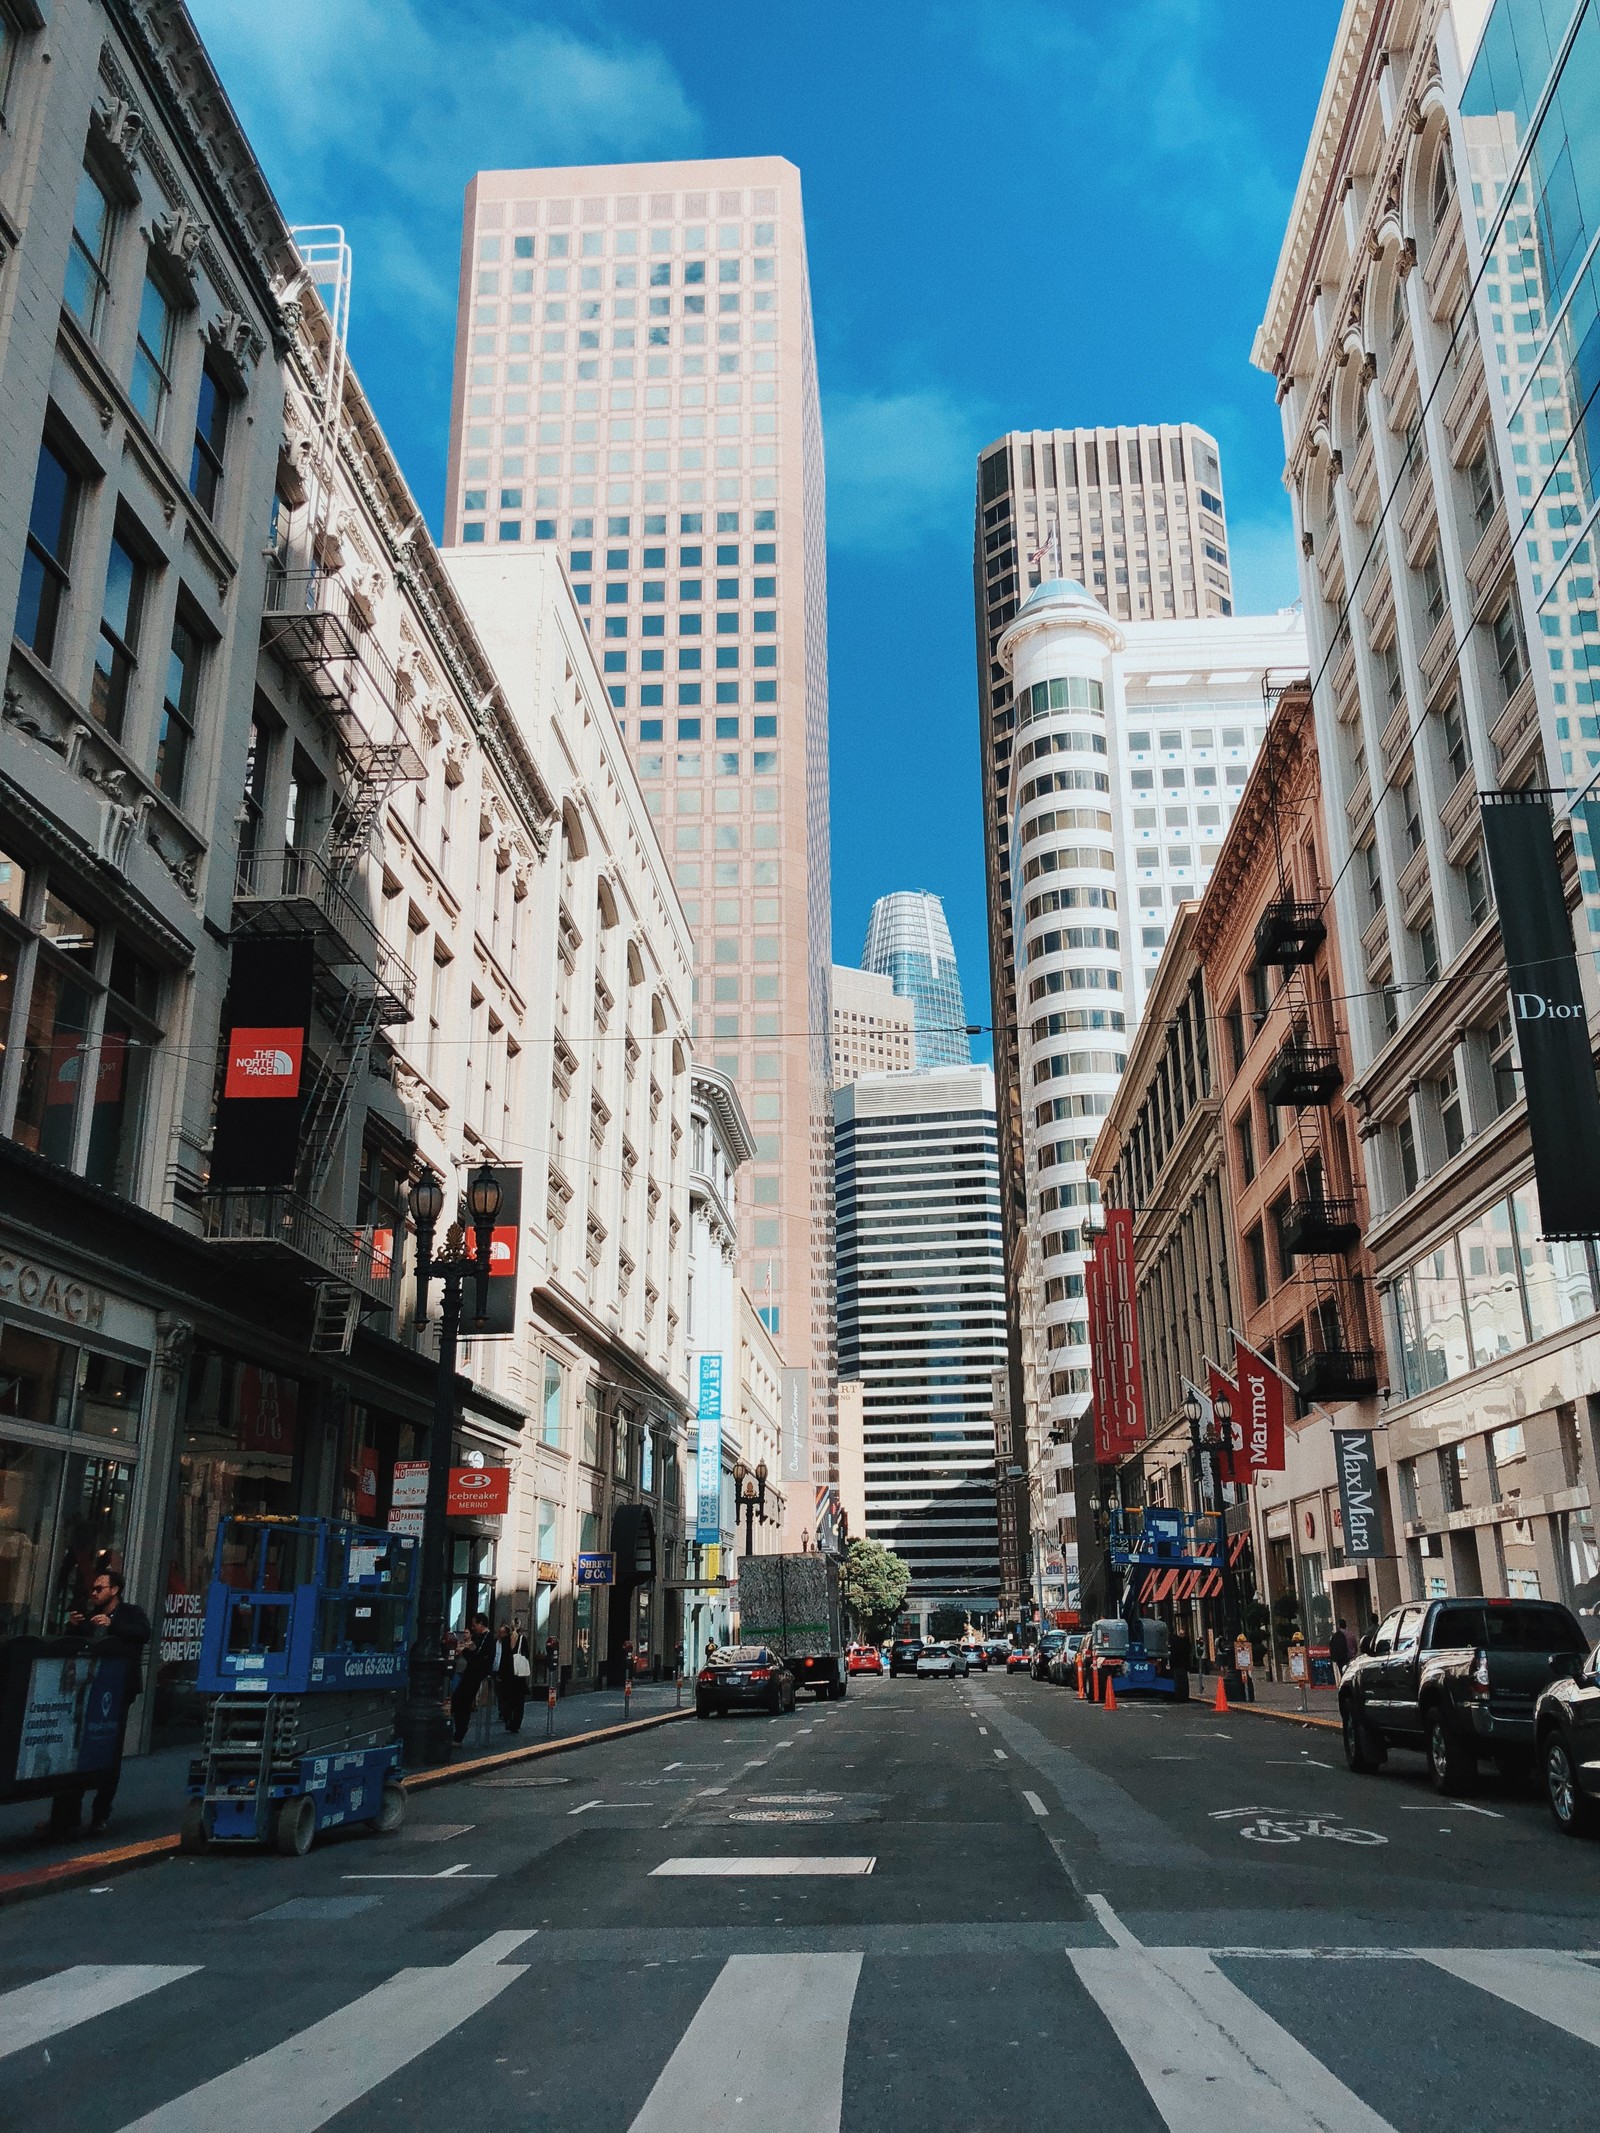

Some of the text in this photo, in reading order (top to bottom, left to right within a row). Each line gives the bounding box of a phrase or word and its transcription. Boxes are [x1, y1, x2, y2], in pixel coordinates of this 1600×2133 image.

[1514, 993, 1583, 1019] Dior
[236, 1058, 274, 1067] NORTH
[253, 1049, 276, 1059] THE
[246, 1066, 274, 1076] FACE
[0, 1257, 105, 1329] COACH
[702, 1358, 710, 1380] FOR
[709, 1358, 720, 1416] RETAIL
[700, 1382, 710, 1416] LEASE
[1247, 1377, 1267, 1465] Marmot
[395, 1469, 405, 1478] NO
[710, 1445, 718, 1483] KAZUKO
[449, 1492, 499, 1500] icebreaker
[1341, 1434, 1375, 1552] MaxMara
[709, 1485, 717, 1524] MORGAN
[389, 1510, 423, 1521] NO PARKING
[579, 1558, 612, 1569] SHREVE
[584, 1569, 594, 1579] &
[162, 1617, 206, 1637] WHEREVE
[344, 1658, 364, 1676] Genie
[1134, 1662, 1149, 1671] 4x4
